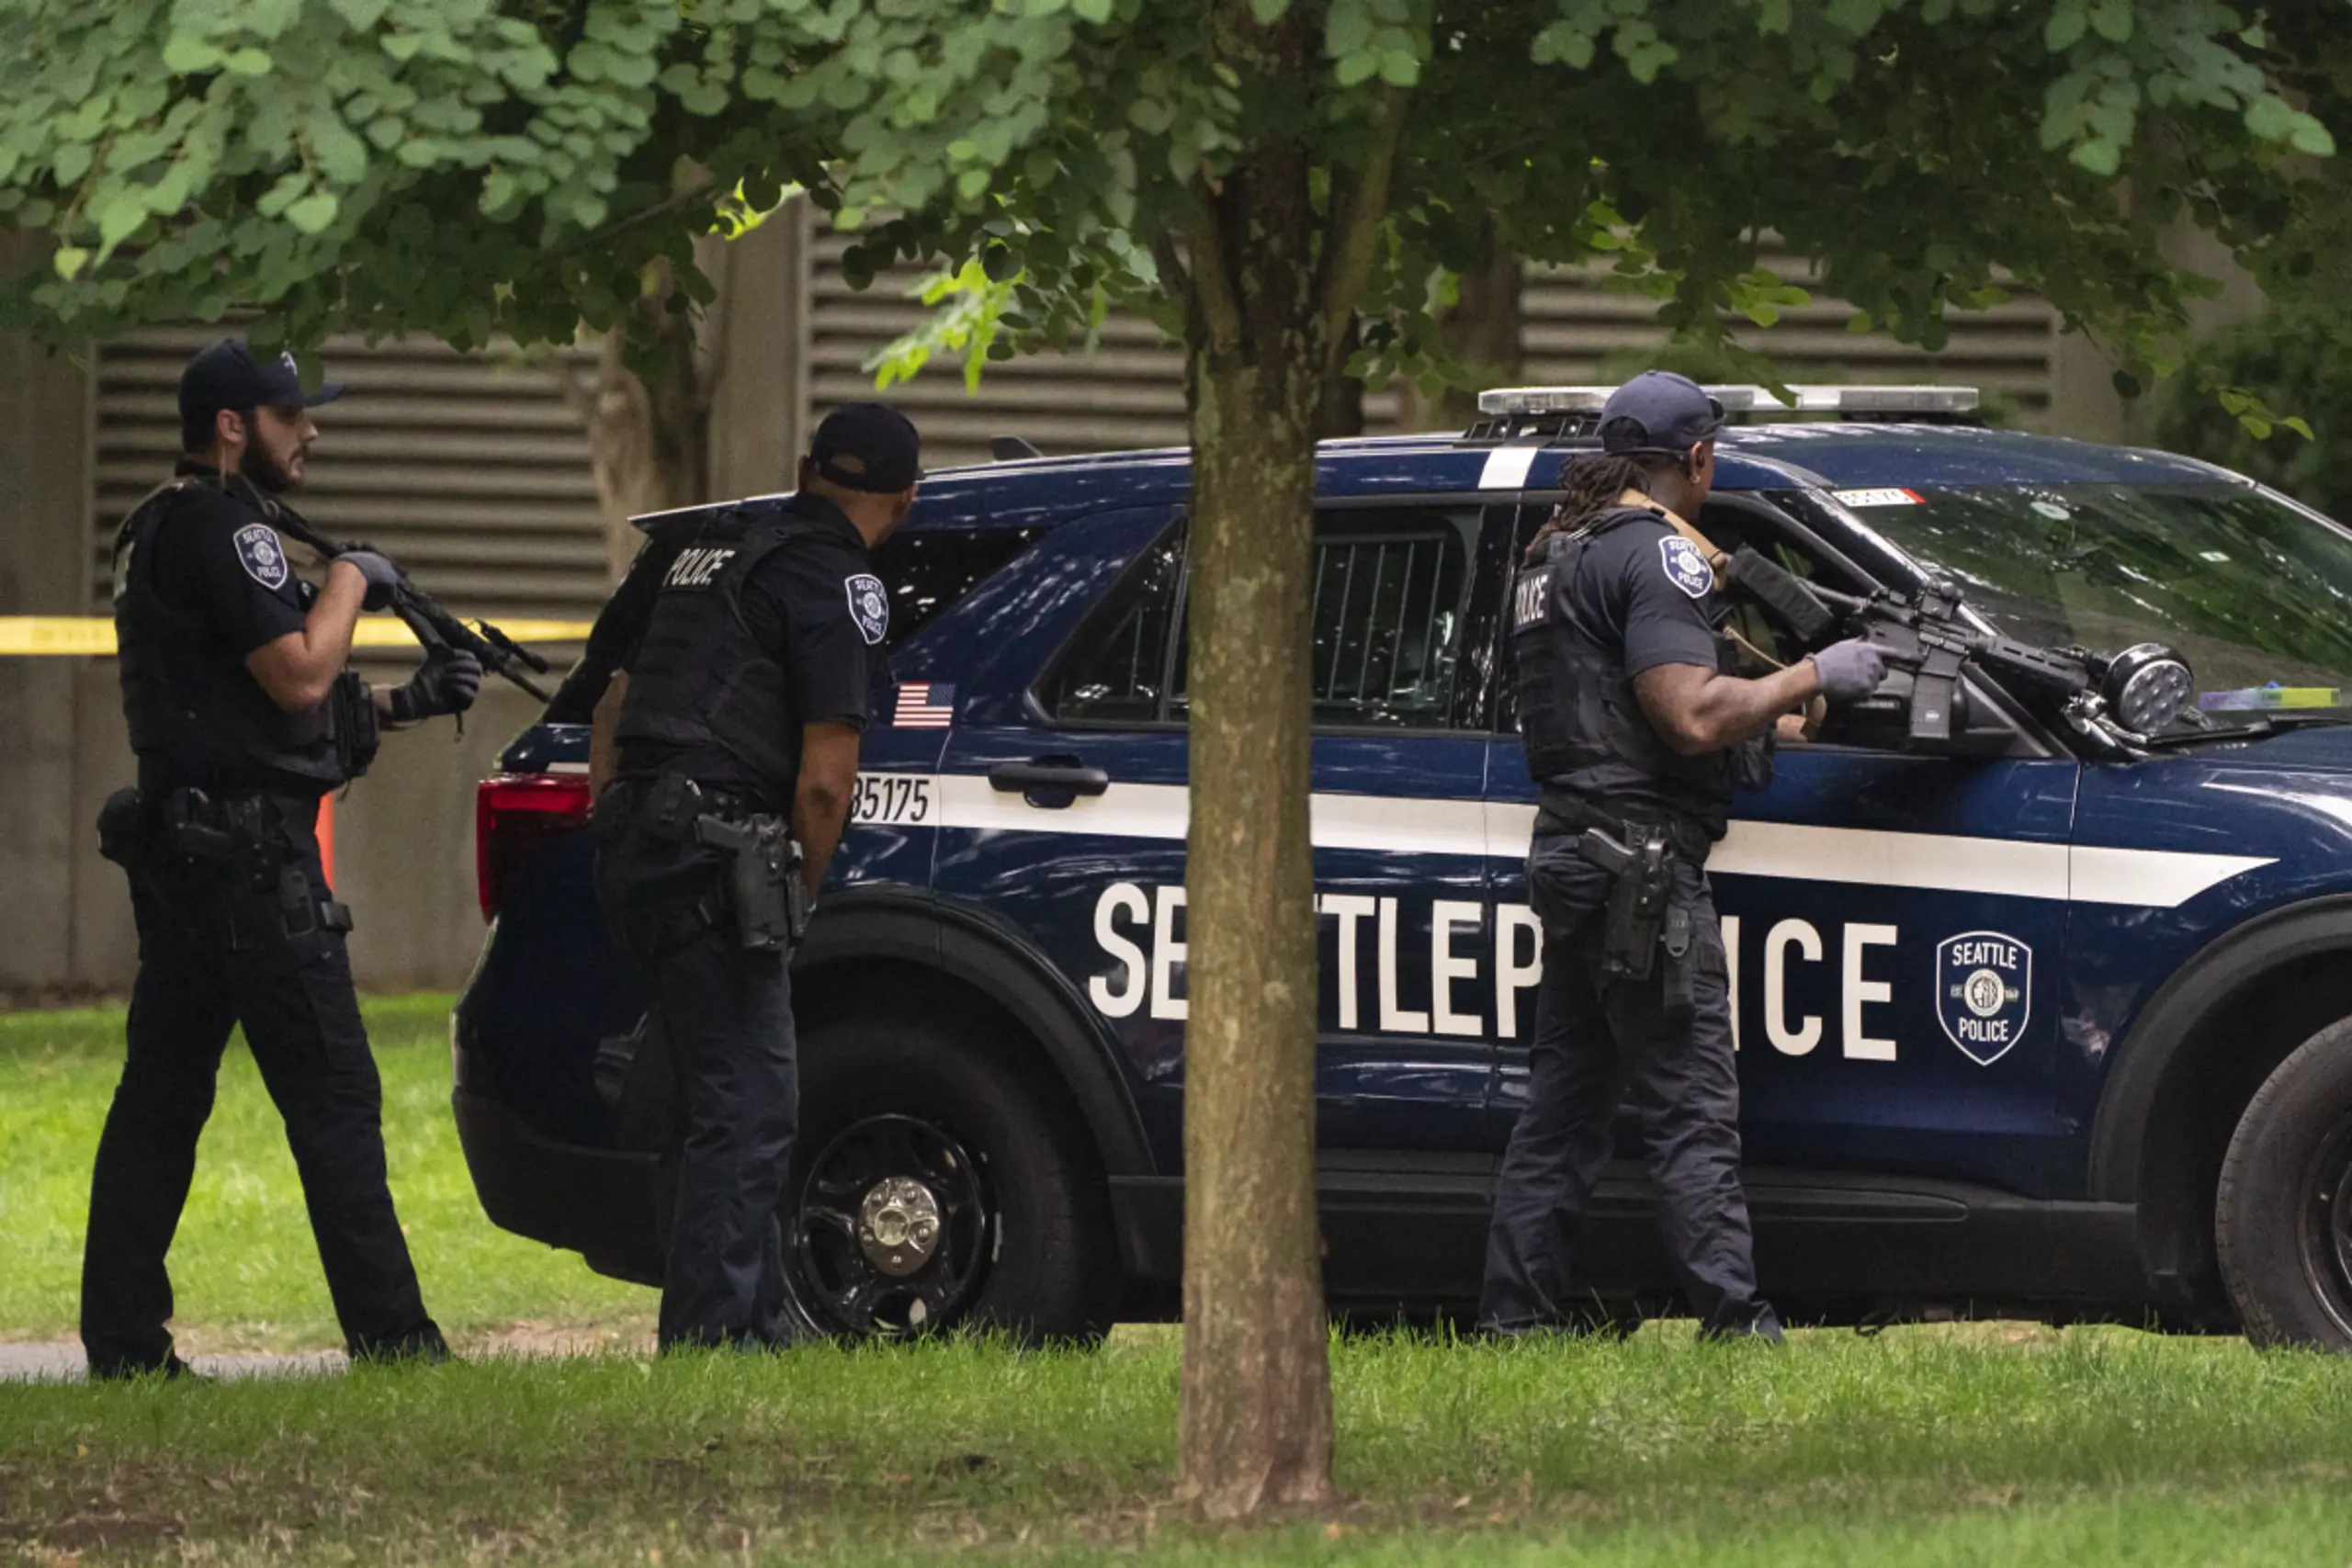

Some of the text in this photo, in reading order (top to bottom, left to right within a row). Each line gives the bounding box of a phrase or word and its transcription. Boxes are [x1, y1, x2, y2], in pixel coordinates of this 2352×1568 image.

[662, 548, 736, 586] POLICE
[1089, 882, 1897, 1062] SETLE PICE
[1951, 942, 2018, 970] SEATTLE
[1958, 1017, 2009, 1042] POLICE
